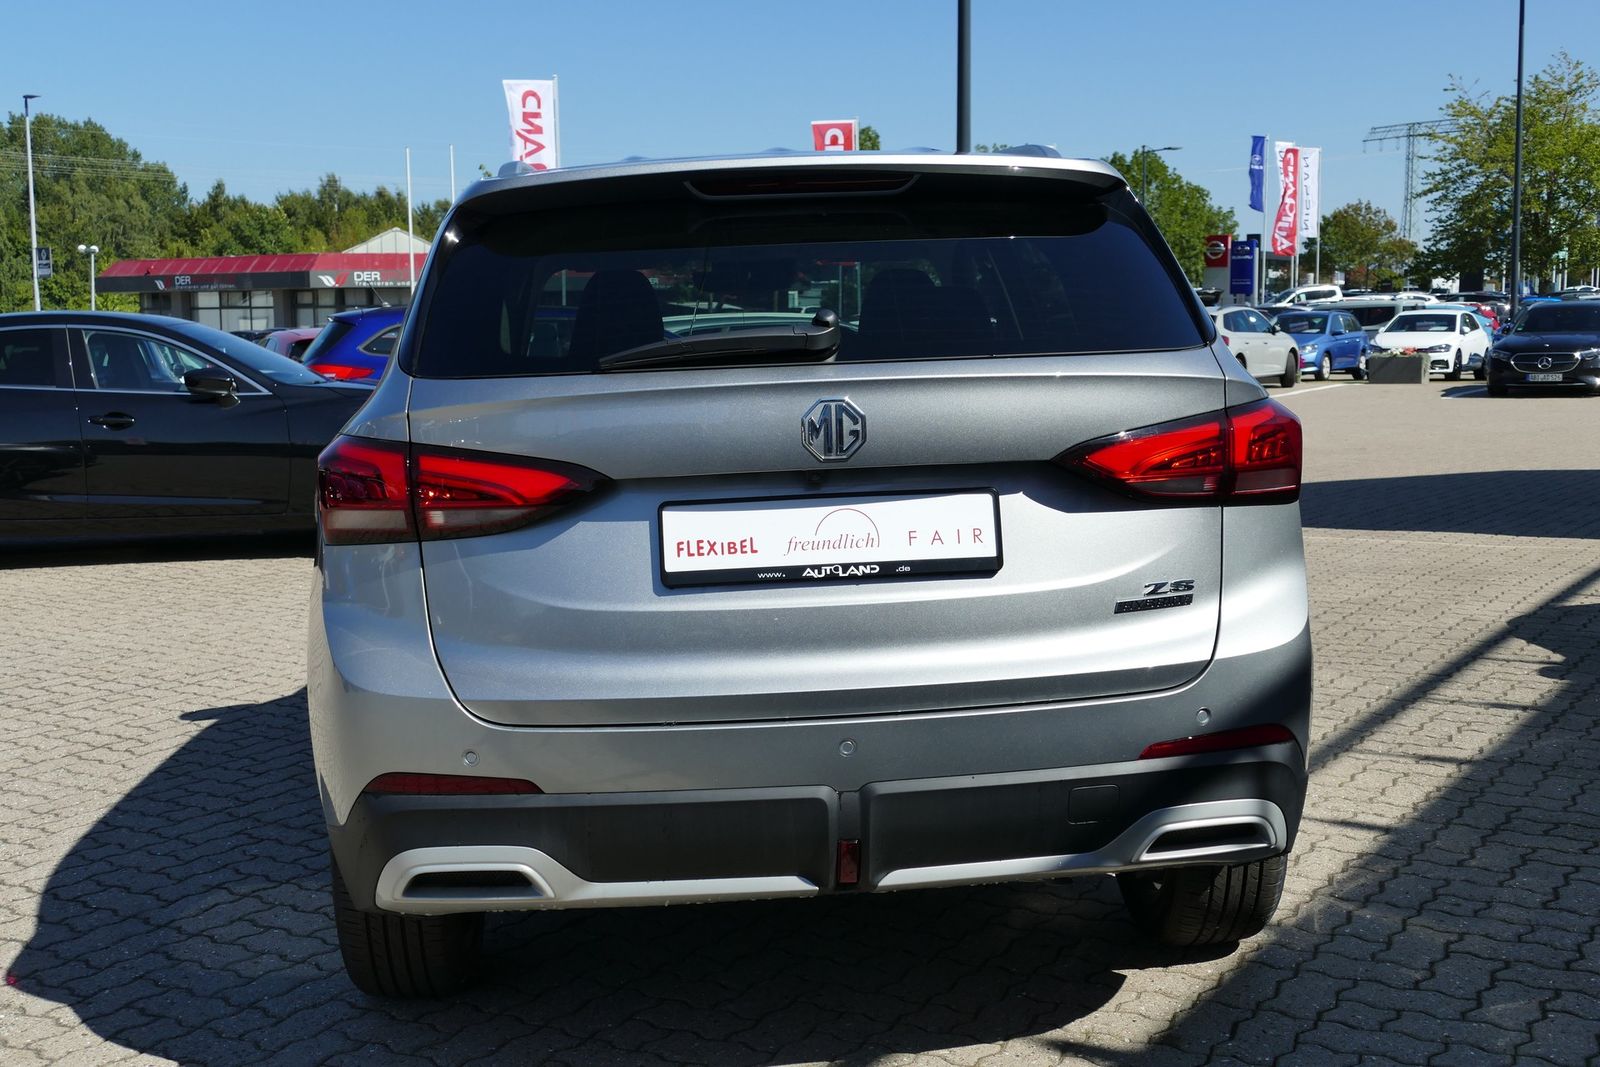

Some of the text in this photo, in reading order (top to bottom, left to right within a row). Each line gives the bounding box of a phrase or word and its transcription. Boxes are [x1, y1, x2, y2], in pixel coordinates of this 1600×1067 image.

[174, 276, 191, 285] DER
[354, 271, 381, 281] DER
[806, 402, 861, 457] MG
[676, 527, 984, 558] FLEXIBEL freundlich FAIR
[802, 564, 880, 578] AUTOLAND
[895, 565, 911, 573] .de
[1143, 579, 1195, 596] ZS
